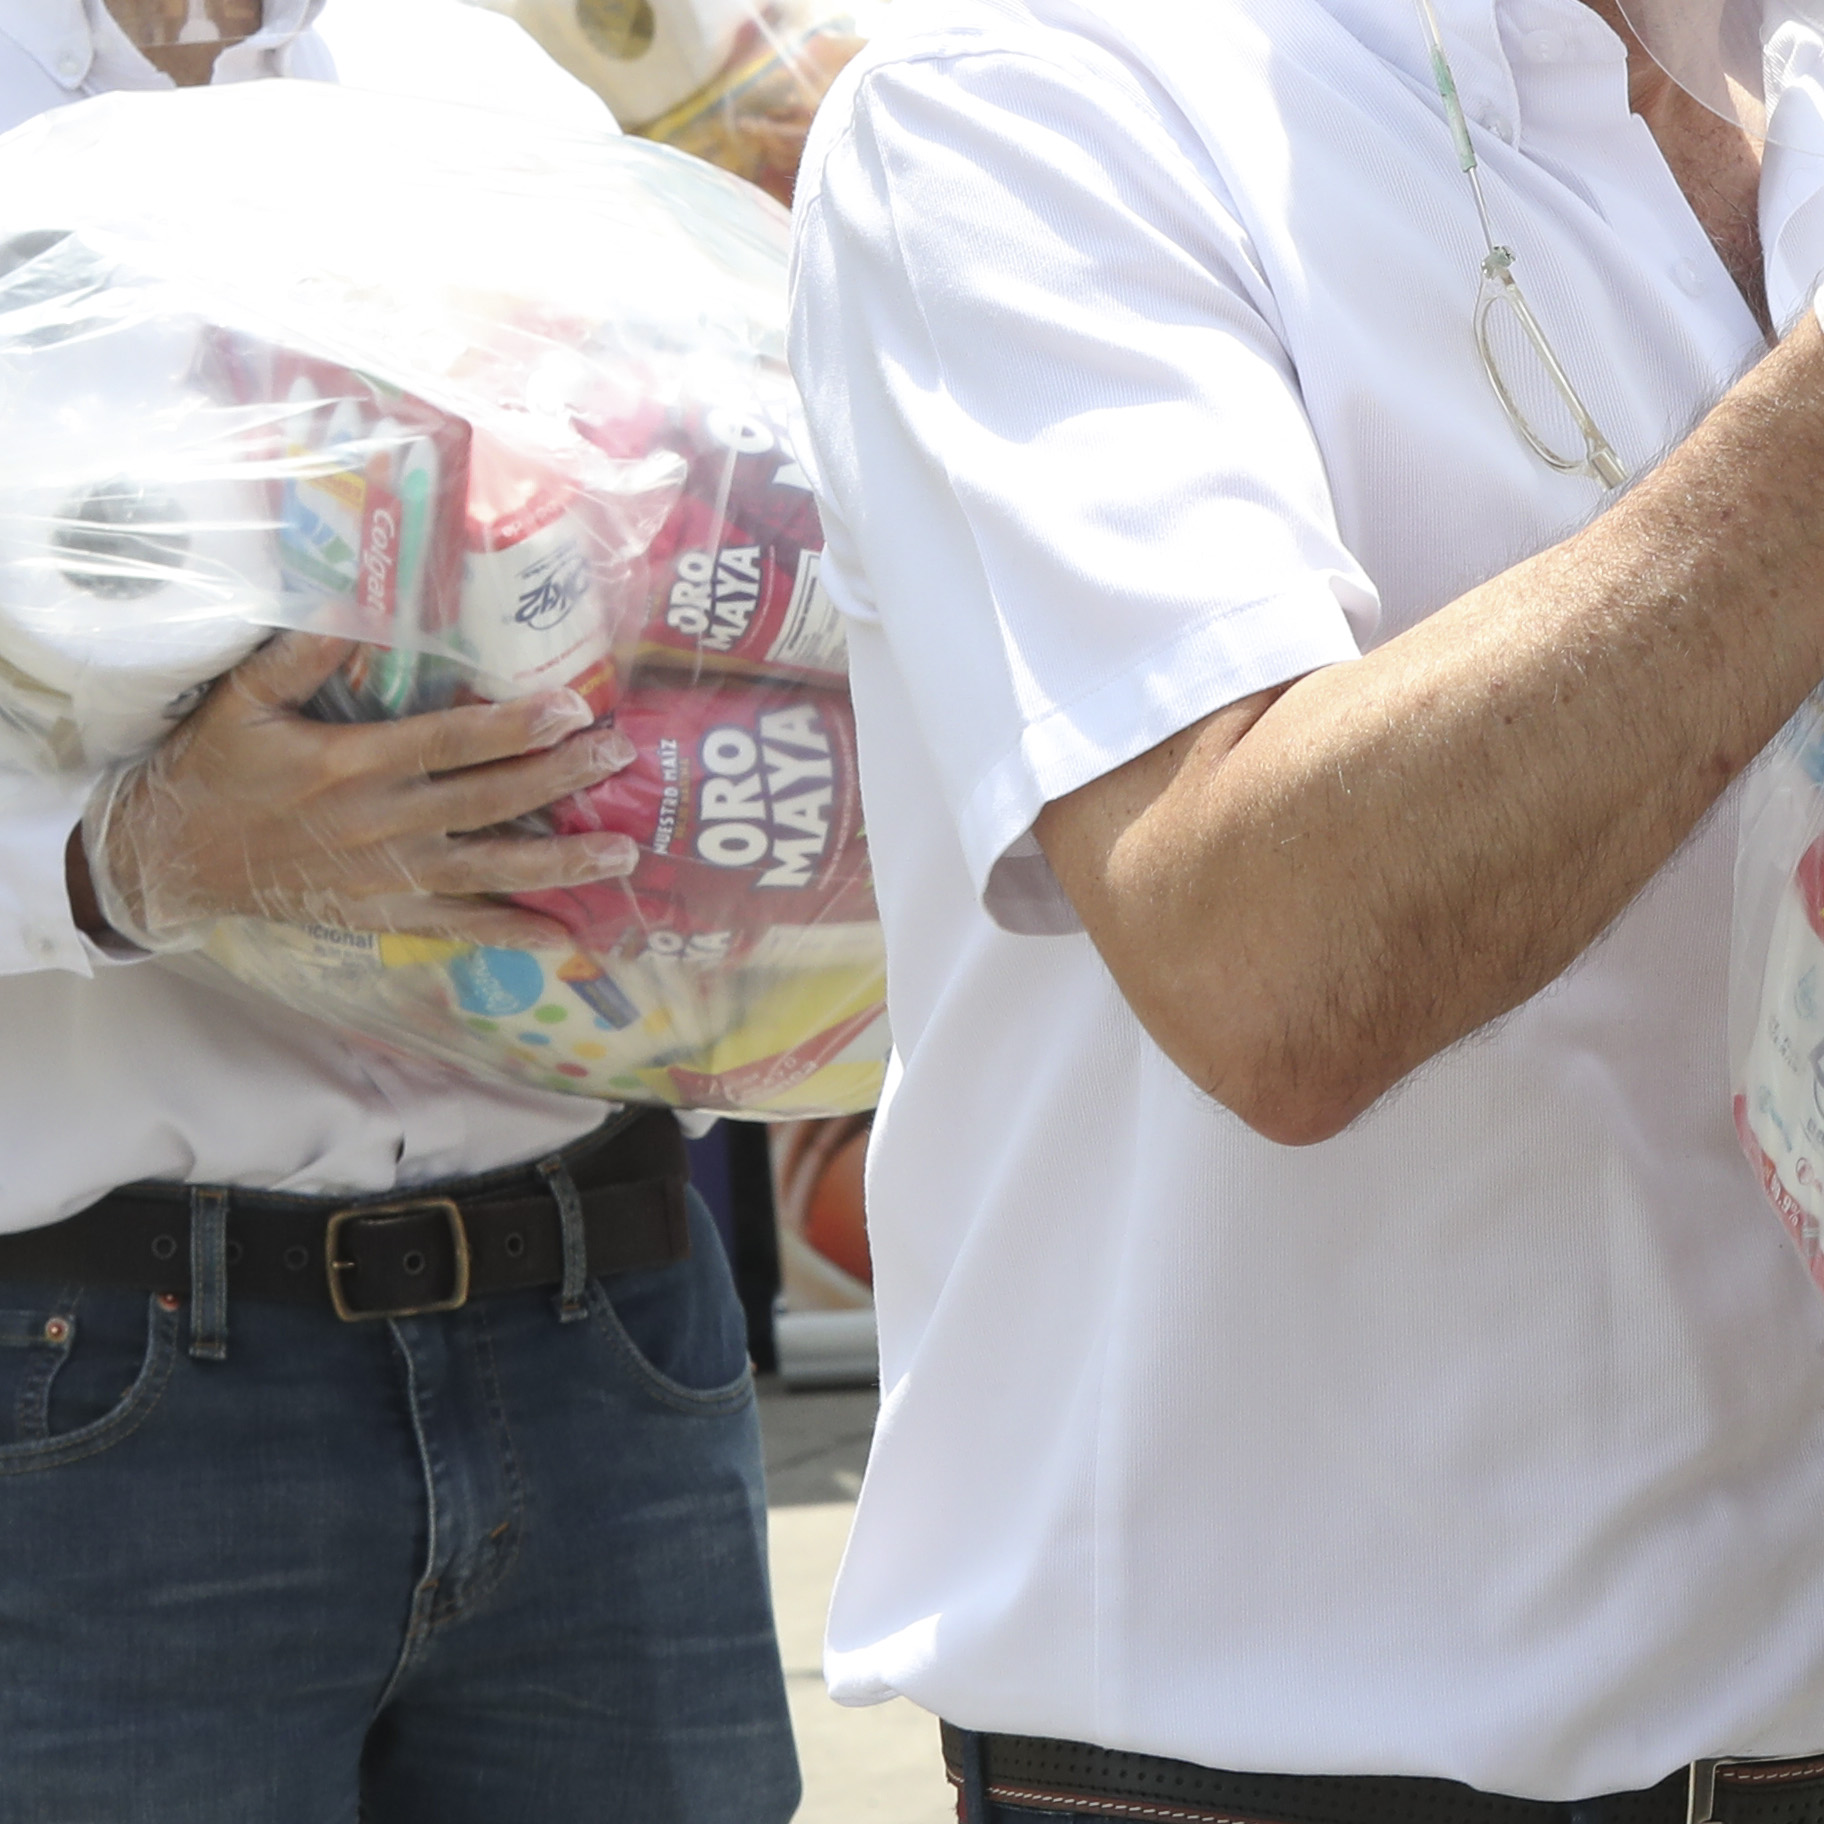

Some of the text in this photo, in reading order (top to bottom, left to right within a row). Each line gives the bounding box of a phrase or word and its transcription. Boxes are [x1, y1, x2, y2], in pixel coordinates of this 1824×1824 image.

[667, 551, 714, 636] ORO
[700, 544, 762, 651] MAYA
[652, 786, 679, 856] NUESTRO
[696, 727, 769, 868] ORO
[755, 702, 834, 887] MAYA
